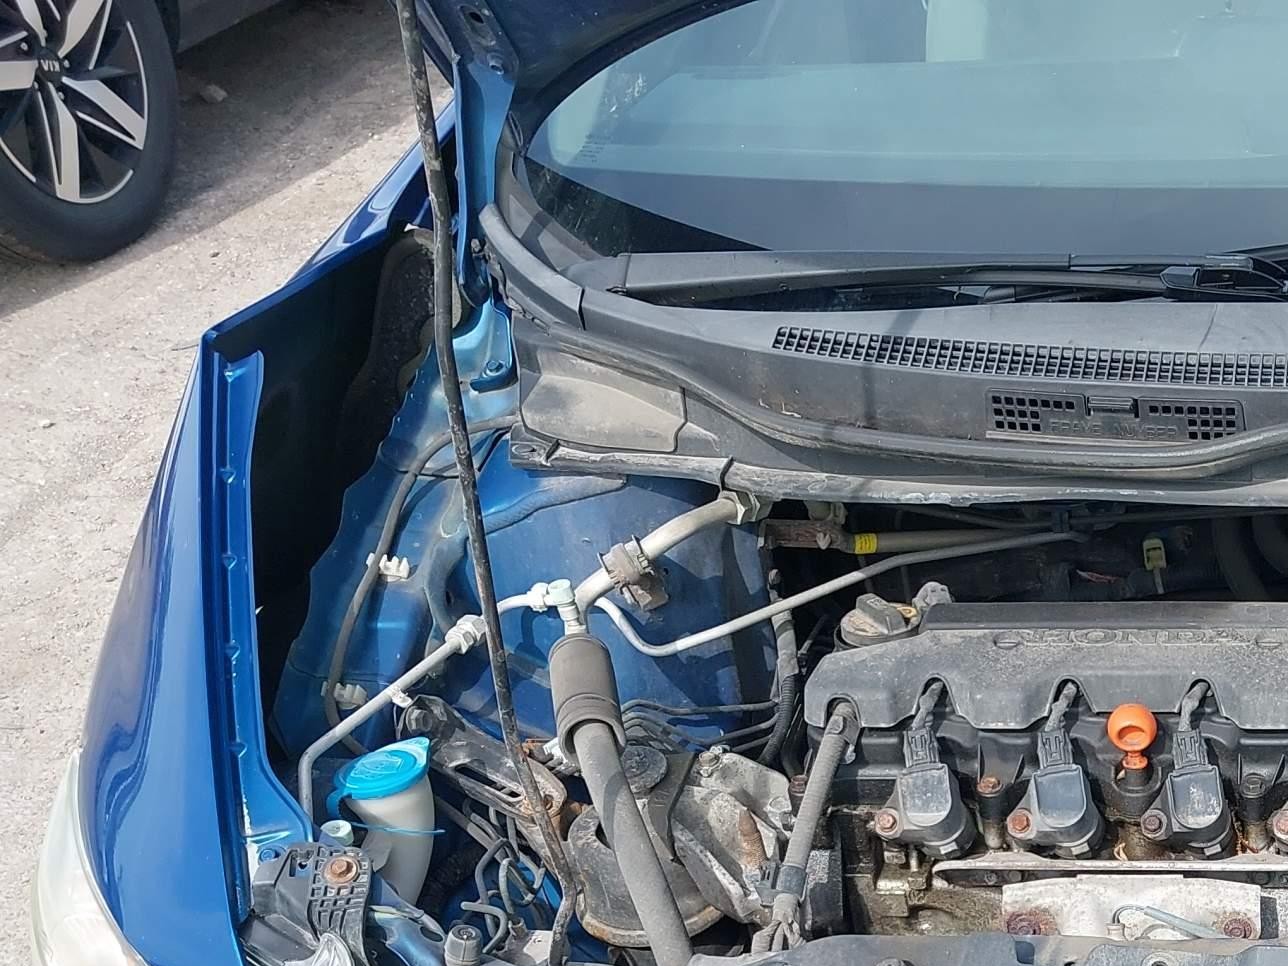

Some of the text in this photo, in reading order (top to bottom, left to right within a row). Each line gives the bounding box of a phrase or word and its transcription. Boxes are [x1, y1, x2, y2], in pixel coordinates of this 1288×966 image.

[40, 59, 61, 73] KIA
[1050, 420, 1102, 434] FRAME
[1023, 628, 1250, 647] HONDA
